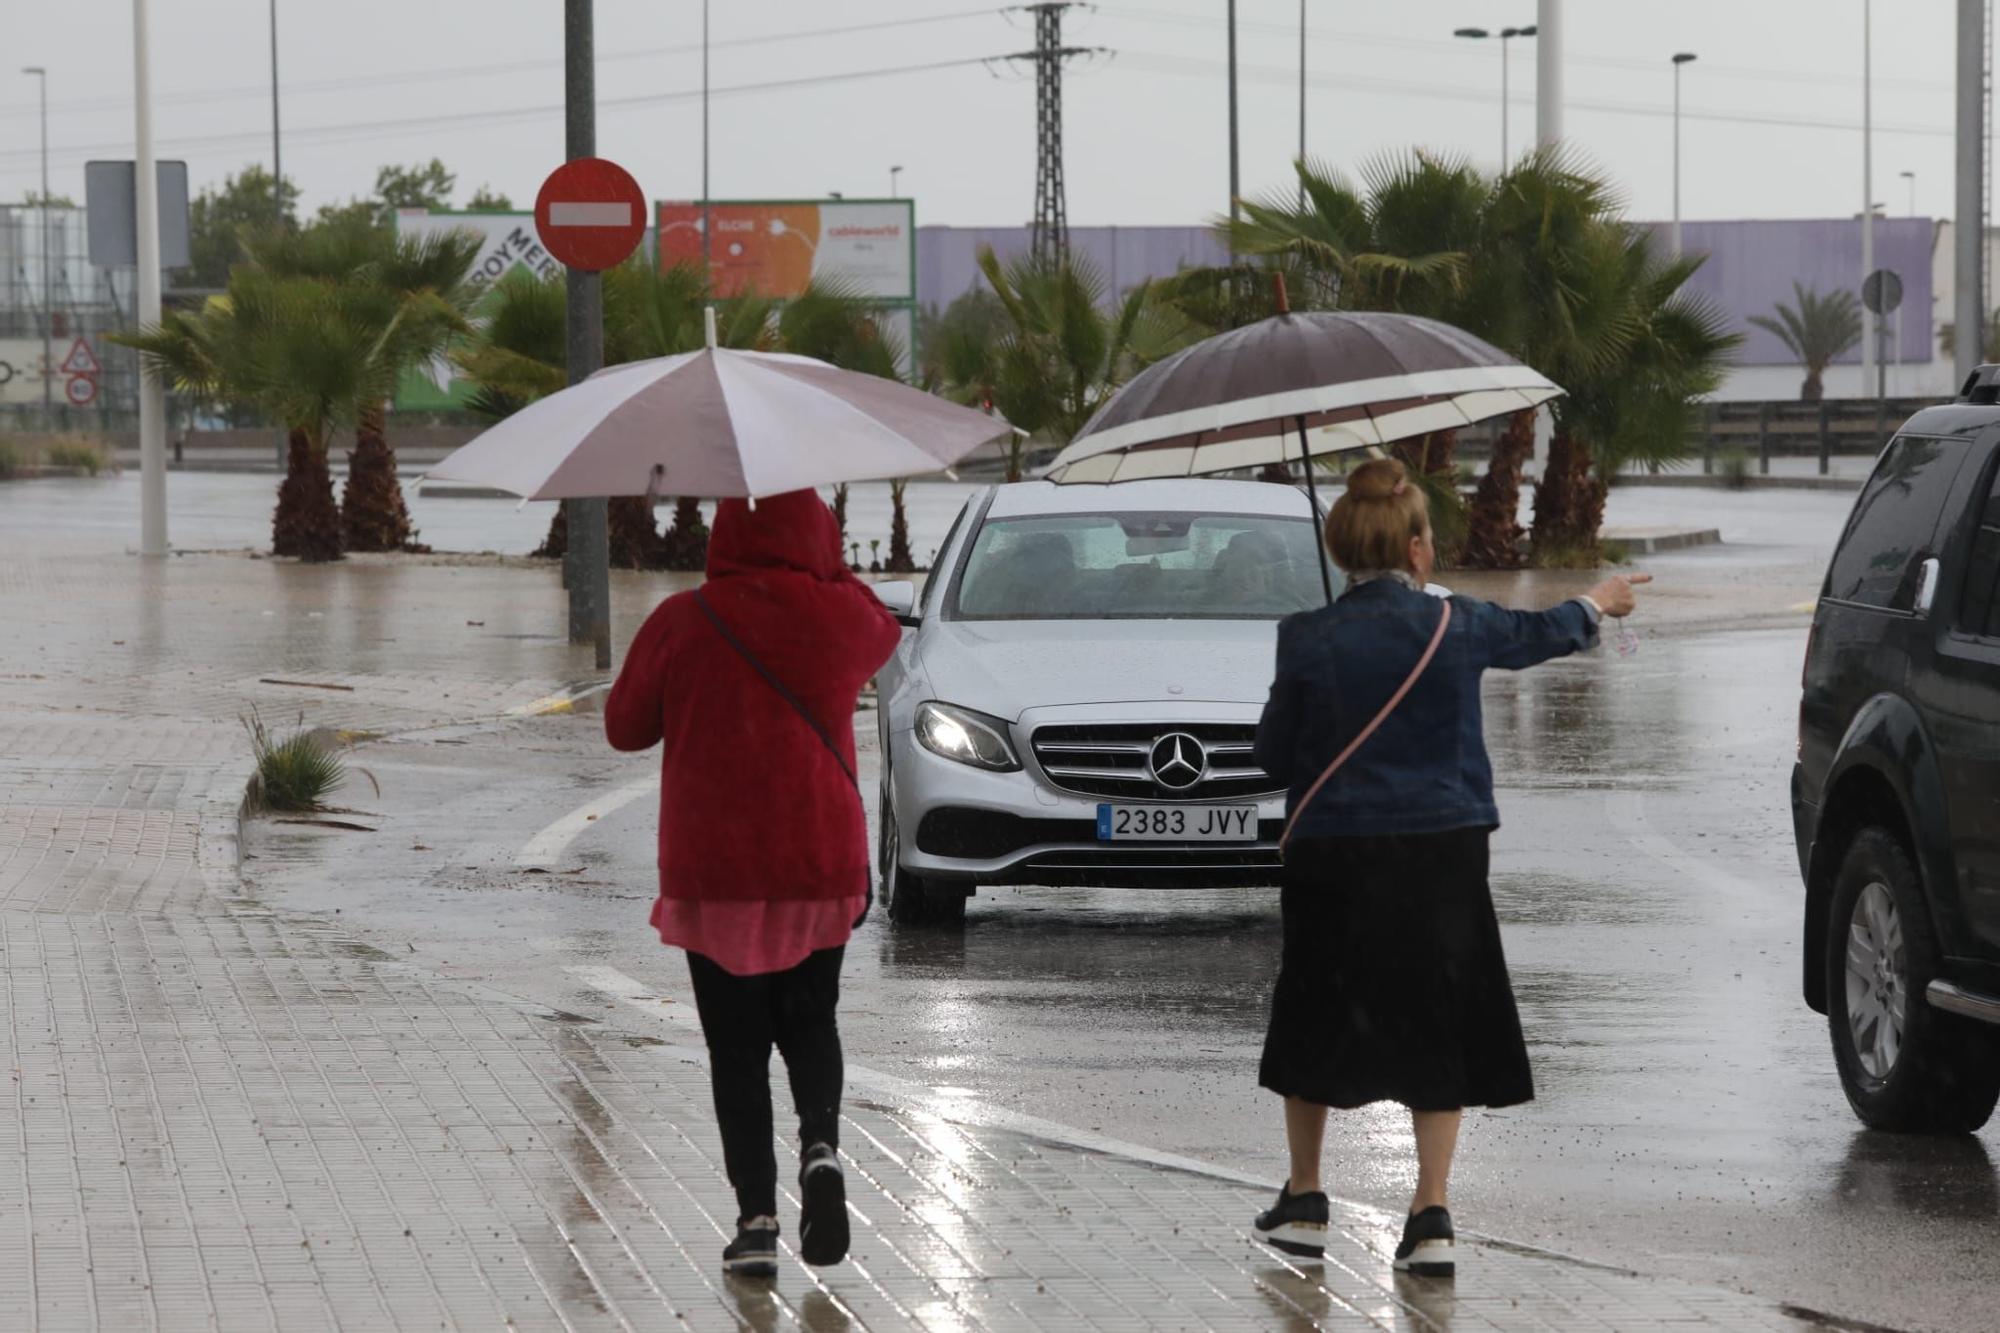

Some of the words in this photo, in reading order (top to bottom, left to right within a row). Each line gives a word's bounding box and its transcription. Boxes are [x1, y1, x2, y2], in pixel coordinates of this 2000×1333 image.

[829, 224, 899, 236] cableworld
[1115, 809, 1185, 834] 2383
[1198, 809, 1250, 834] JVY
